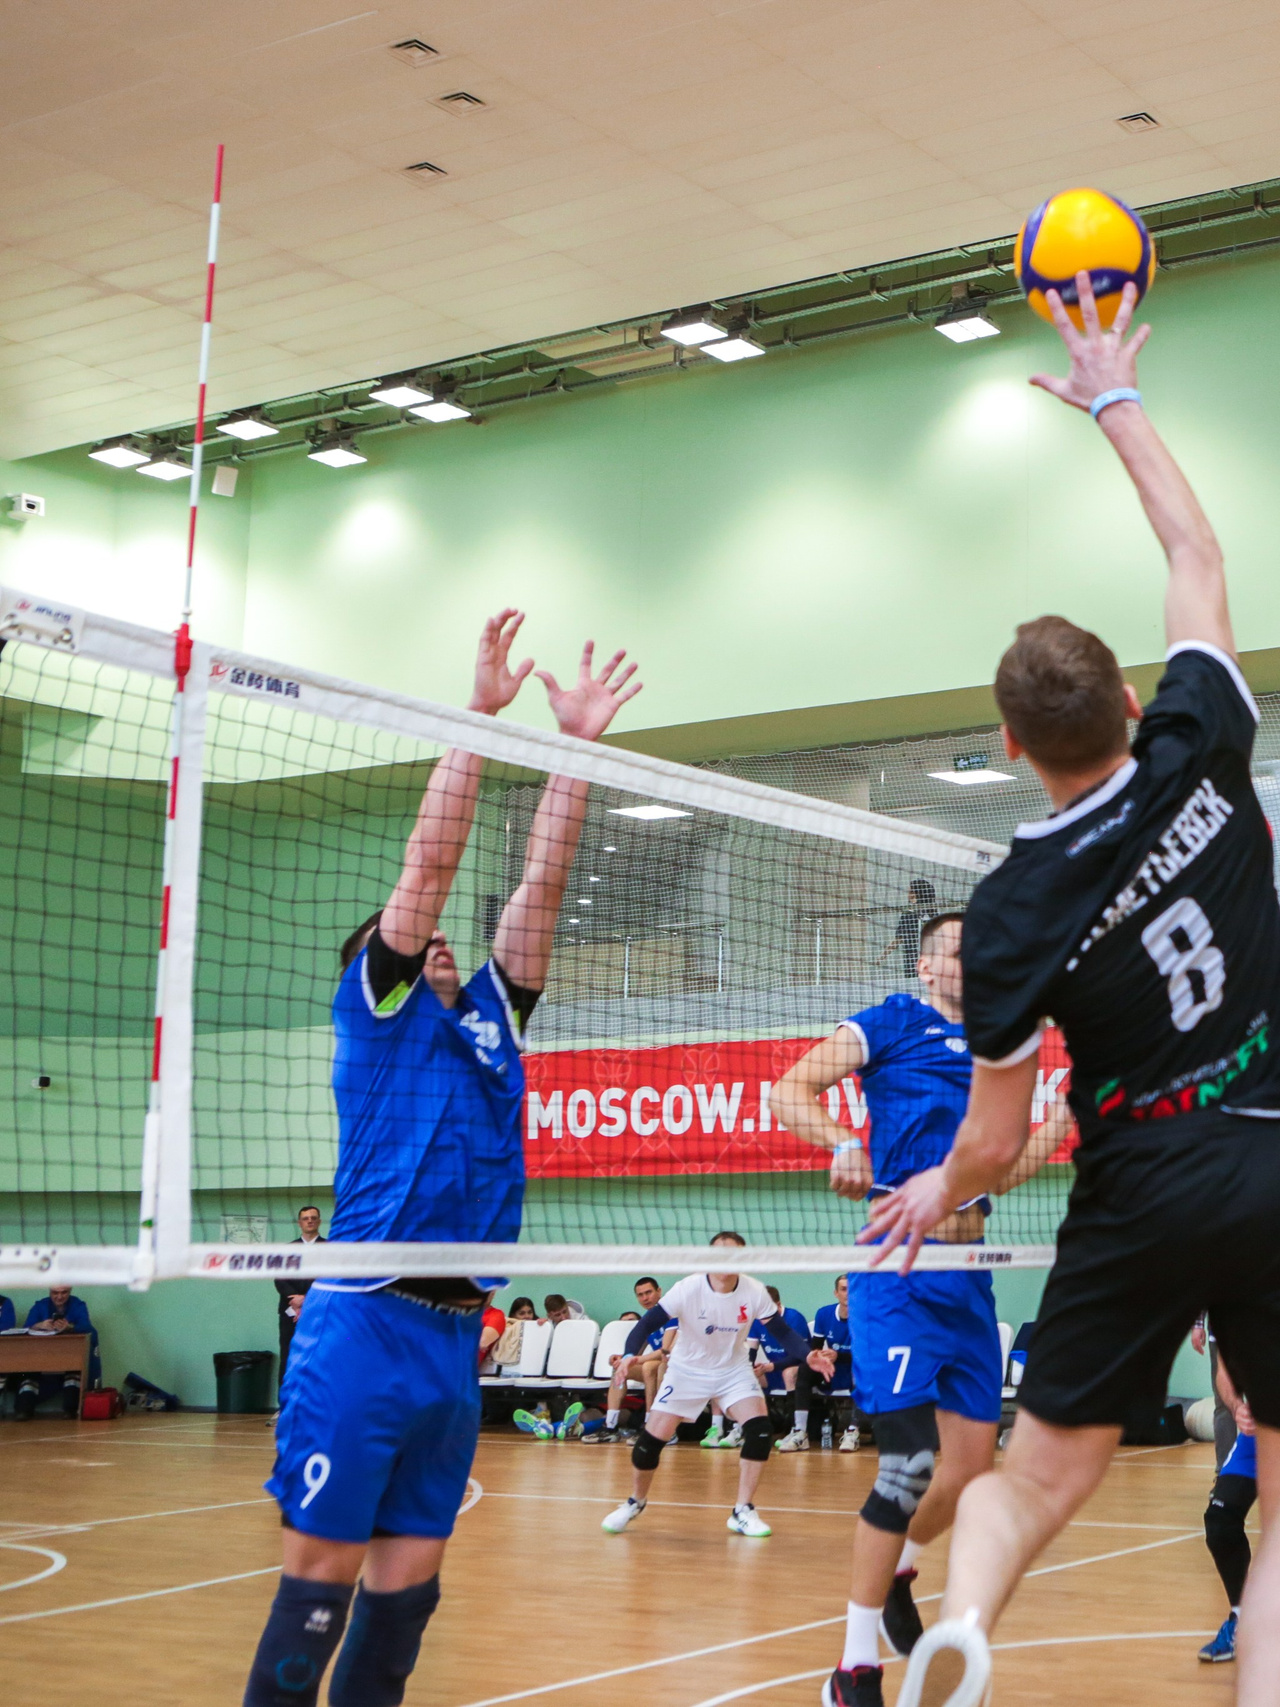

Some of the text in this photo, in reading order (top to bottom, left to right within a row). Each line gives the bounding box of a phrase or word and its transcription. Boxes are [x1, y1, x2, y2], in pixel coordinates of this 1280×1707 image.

[1140, 896, 1227, 1033] 8
[659, 1385, 674, 1404] 2
[887, 1345, 912, 1395] 7
[300, 1452, 332, 1510] 9
